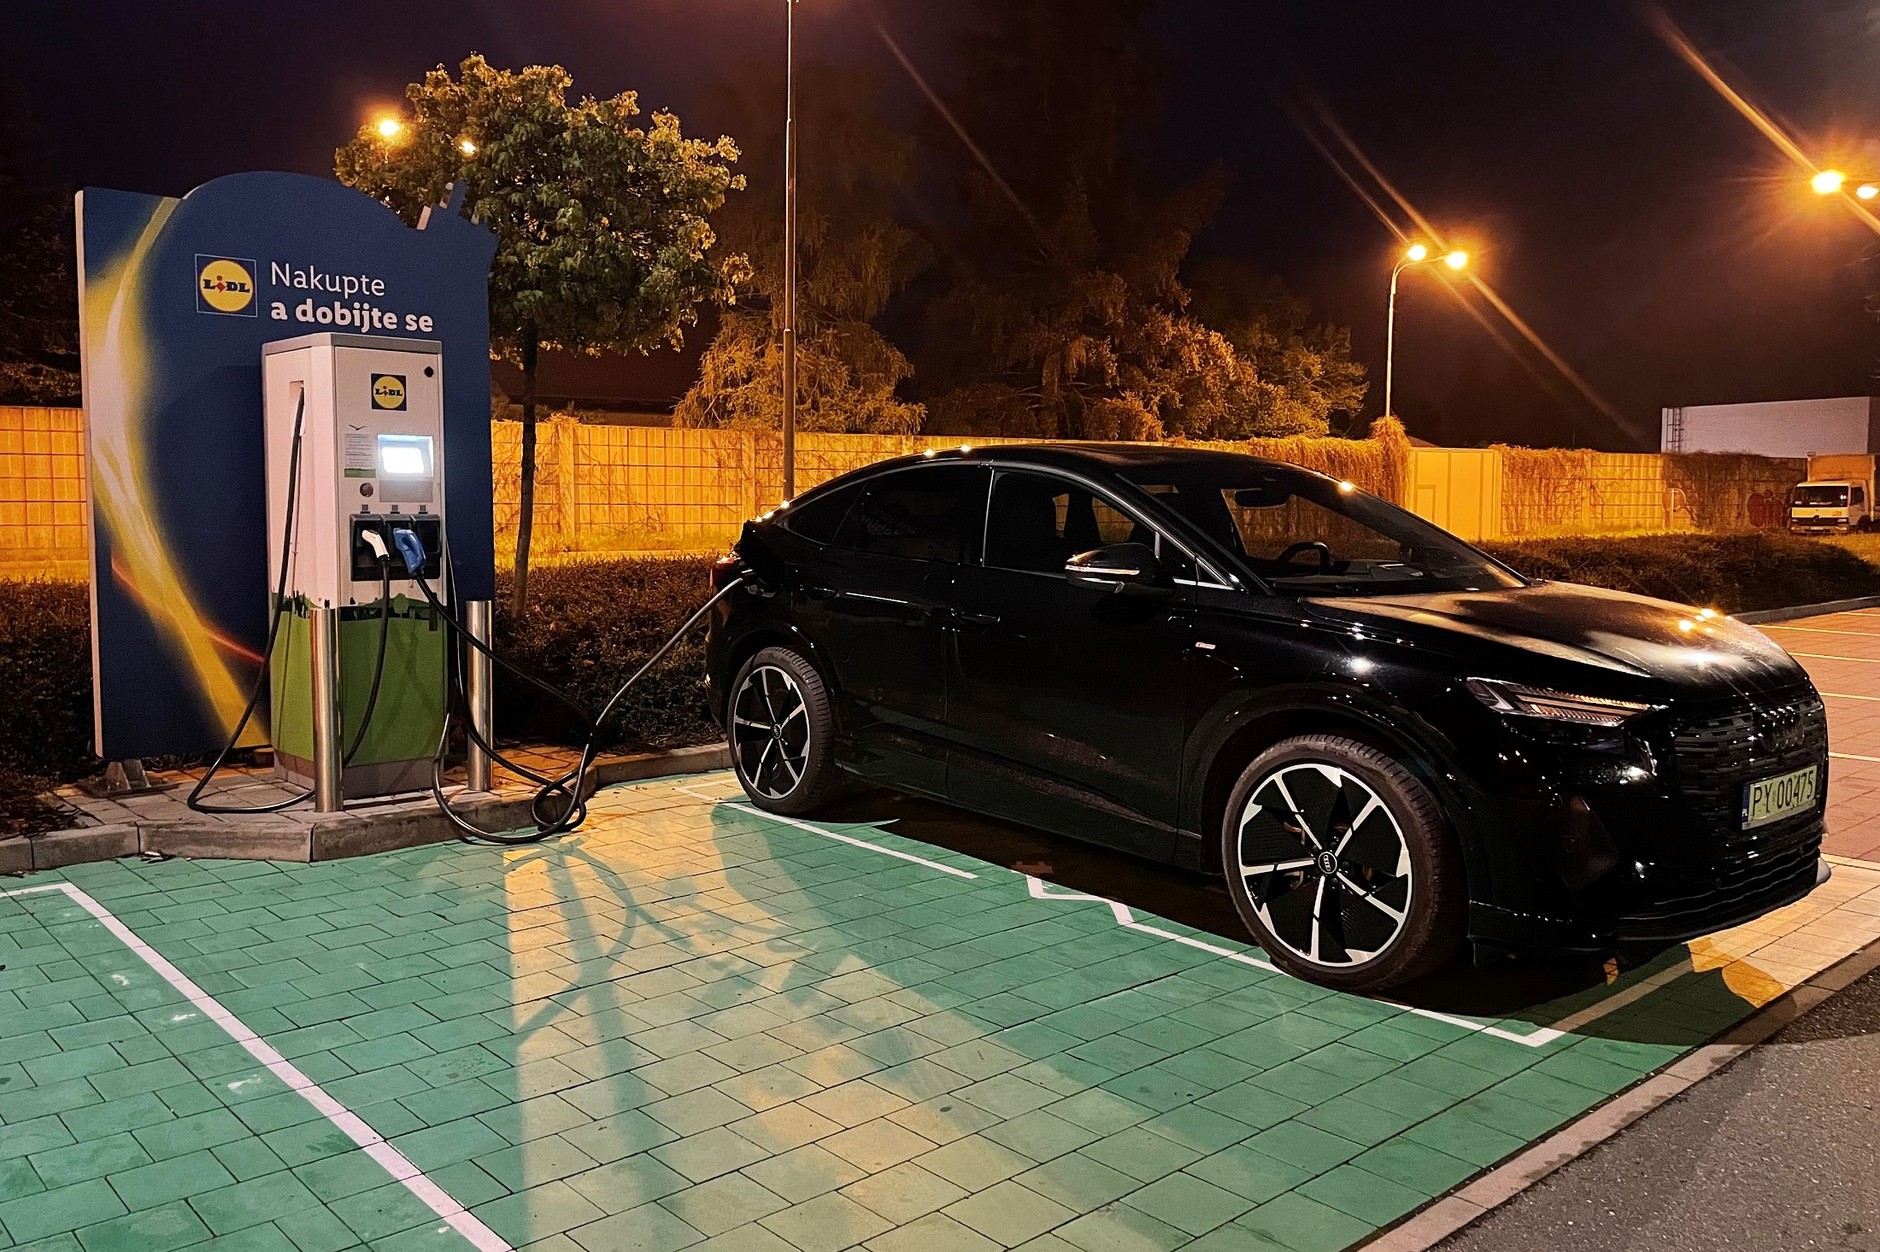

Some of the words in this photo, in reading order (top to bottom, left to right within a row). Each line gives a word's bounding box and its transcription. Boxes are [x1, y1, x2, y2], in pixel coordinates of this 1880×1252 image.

[271, 261, 385, 299] Nakupte
[271, 301, 288, 320] a
[295, 298, 398, 333] dobijte
[405, 313, 433, 332] se
[1753, 783, 1772, 817] PY
[1777, 770, 1814, 809] 00475
